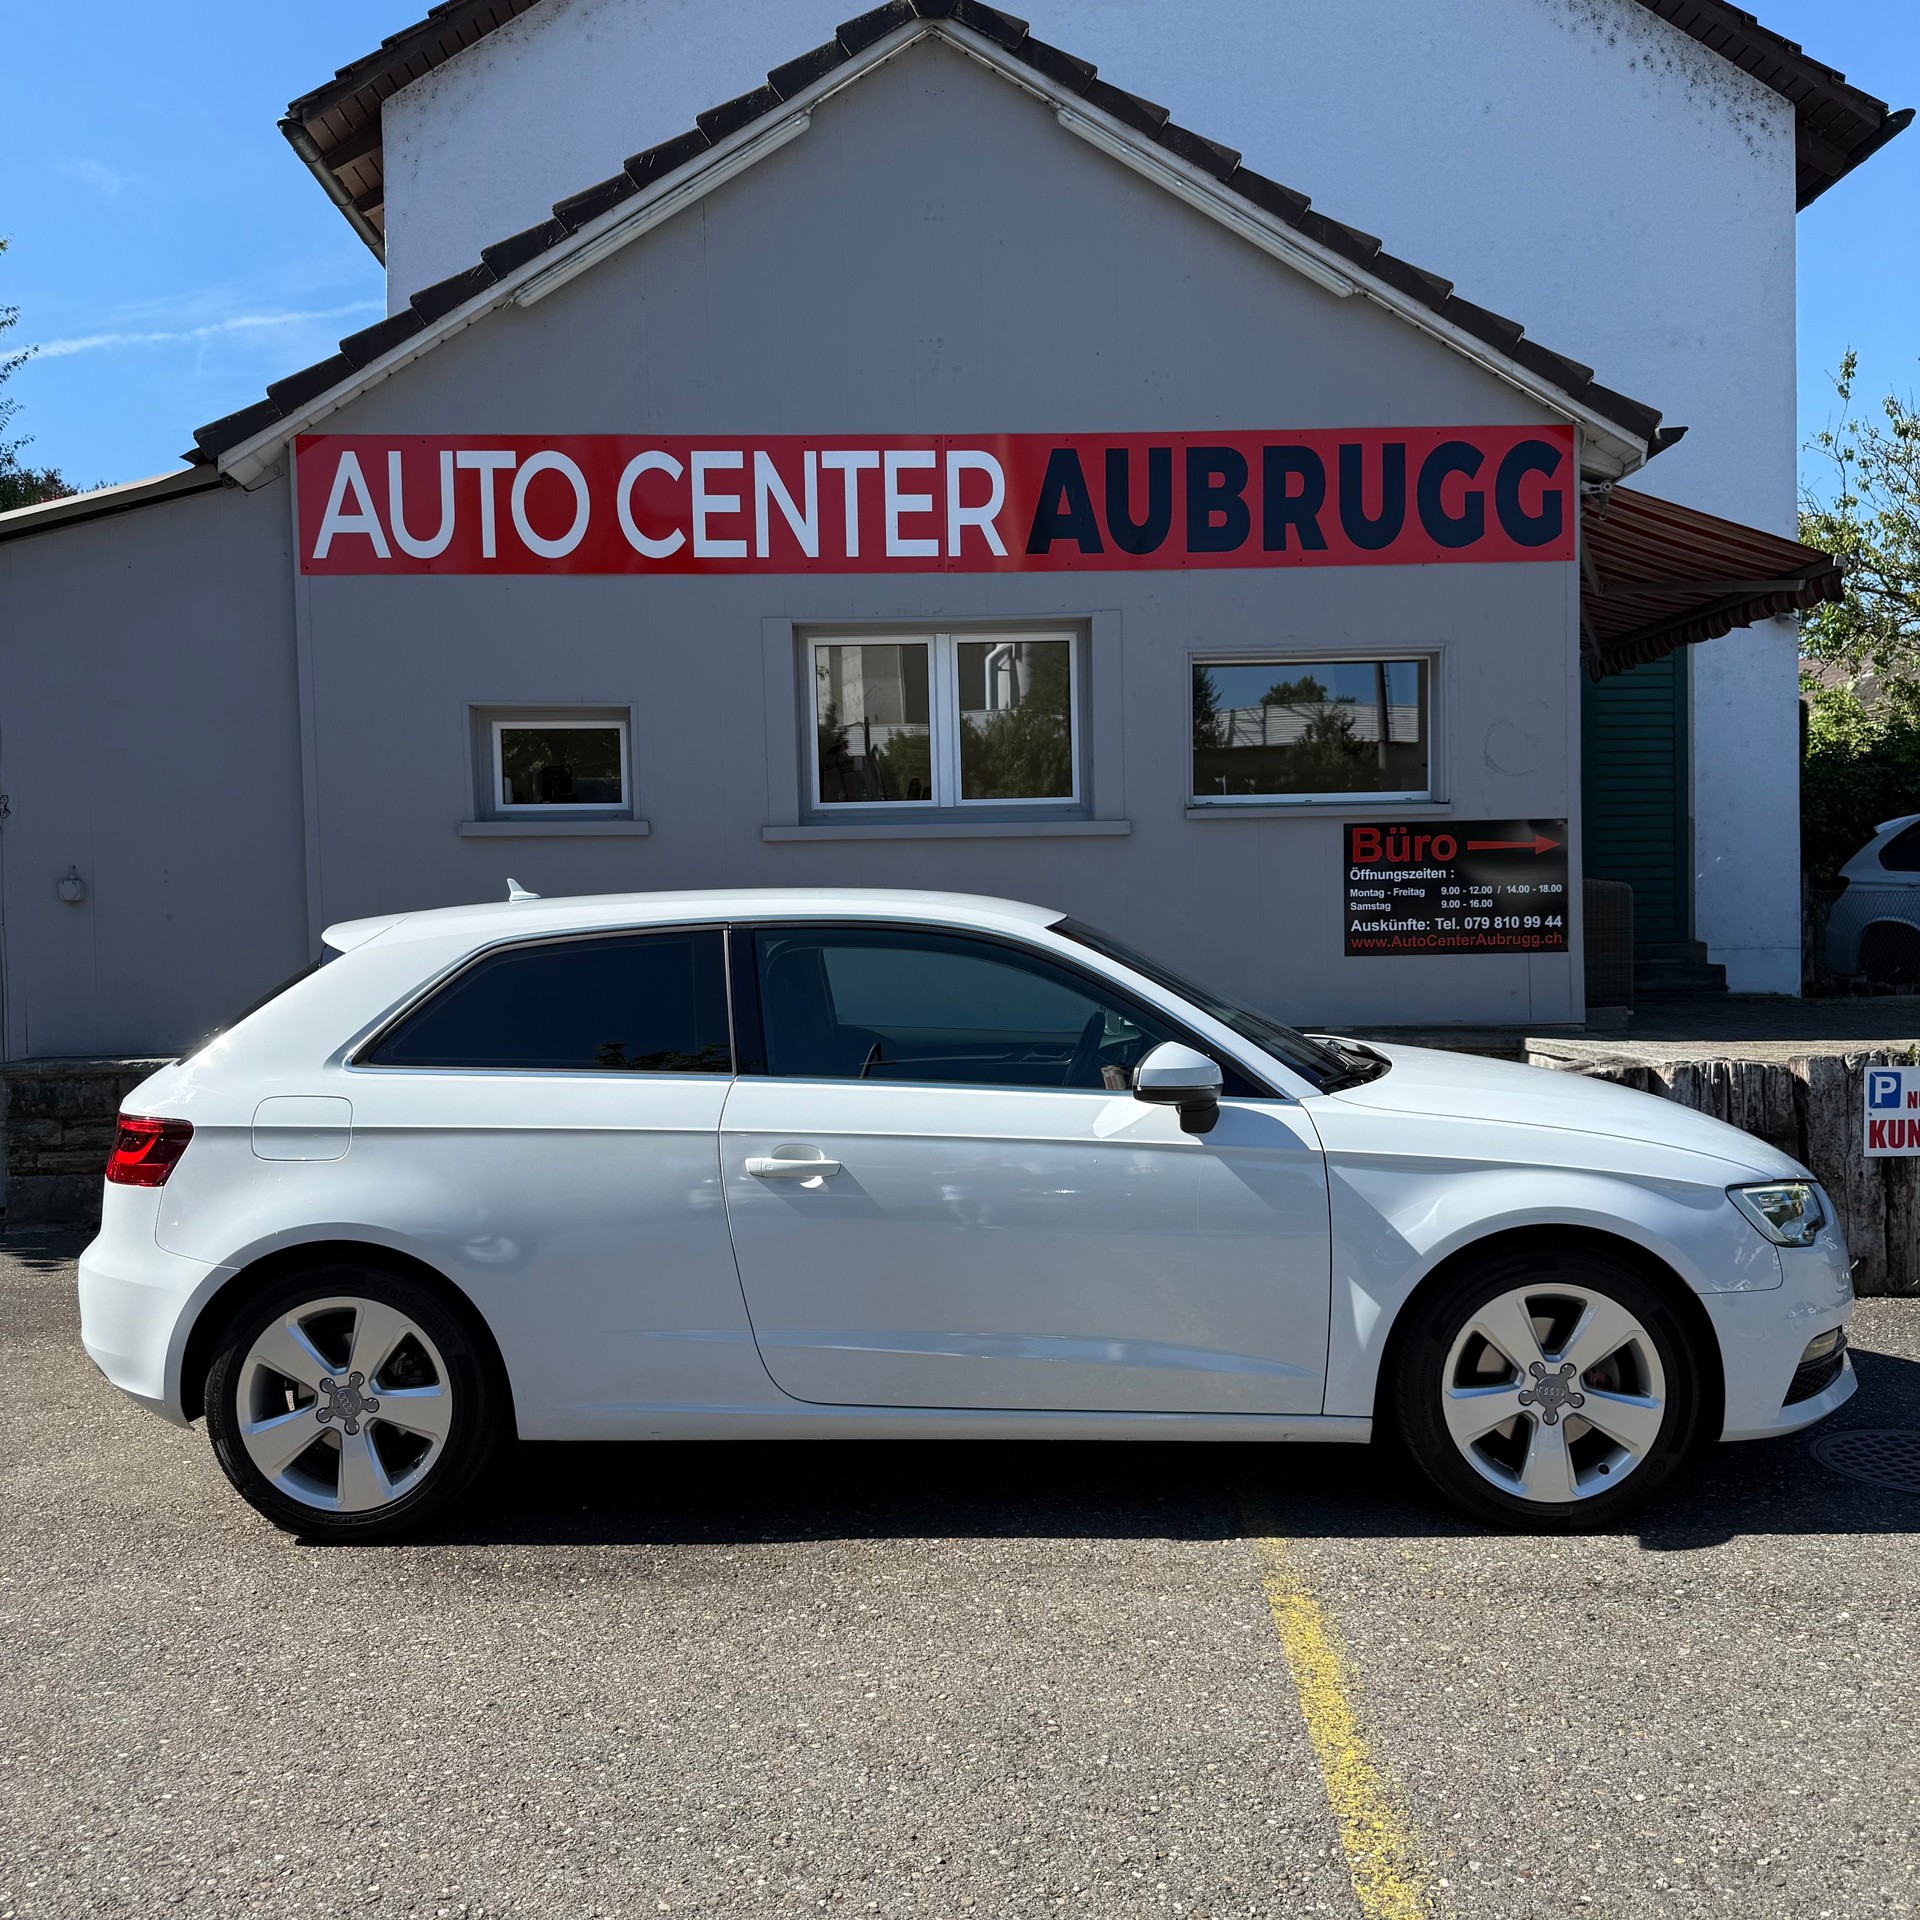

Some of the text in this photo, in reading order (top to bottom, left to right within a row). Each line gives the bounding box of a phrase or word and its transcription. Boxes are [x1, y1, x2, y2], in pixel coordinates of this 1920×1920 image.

[313, 440, 1563, 559] AUTO CENTER AUBRUGG
[1352, 827, 1457, 863] Büro
[1350, 867, 1446, 882] Öffnungszeiten
[1350, 888, 1384, 898] Montag
[1394, 887, 1425, 897] Freitag
[1441, 886, 1460, 895] 9.00
[1469, 886, 1492, 895] 12.00
[1506, 885, 1529, 893] 14.00
[1539, 884, 1562, 893] 18.00
[1350, 902, 1391, 911] Samstag
[1441, 900, 1460, 909] 9.00
[1469, 900, 1493, 908] 16.00
[1351, 915, 1562, 932] Auskünfte: Tel. 079 810 99 44
[1352, 932, 1562, 948] www.AutoCenterAubrugg.ch
[1875, 1077, 1897, 1103] P
[1907, 1091, 1920, 1109] N
